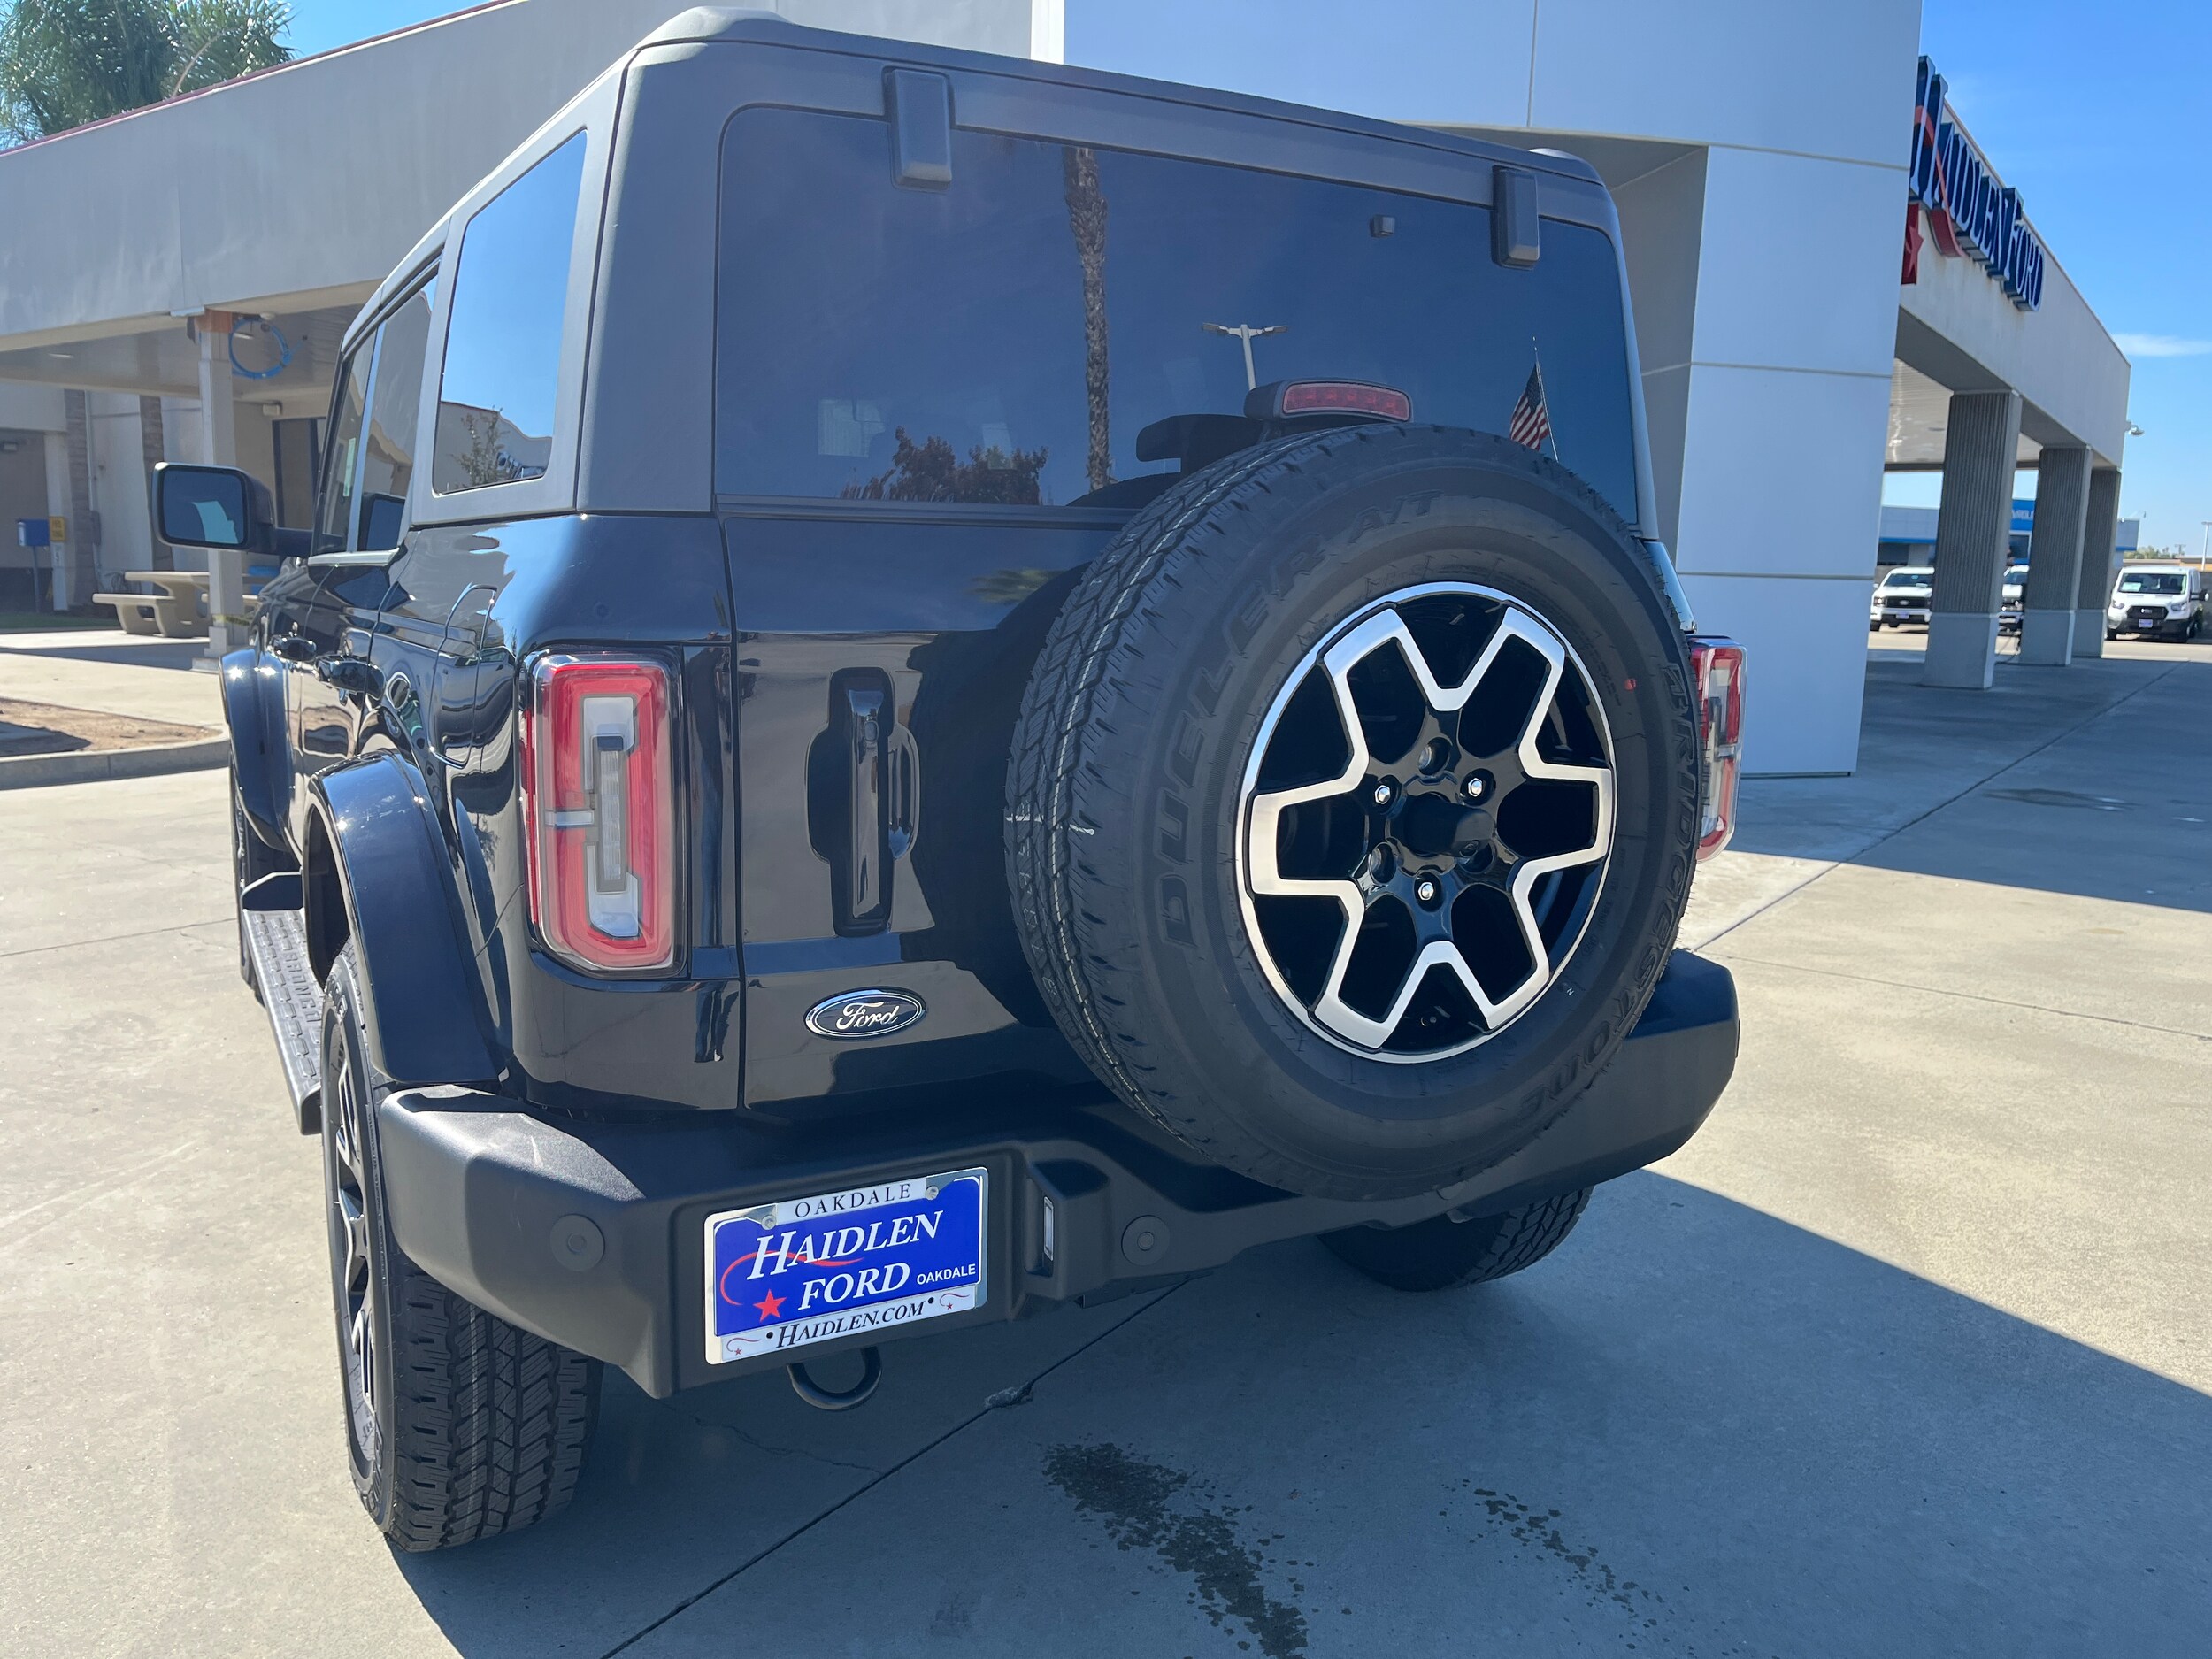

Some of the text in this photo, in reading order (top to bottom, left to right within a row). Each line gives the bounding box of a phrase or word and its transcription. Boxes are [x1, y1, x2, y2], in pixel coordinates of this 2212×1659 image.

[2004, 221, 2045, 311] FORD
[1154, 533, 1327, 947] DUELER
[1520, 662, 1698, 1118] BRIDGESTONE
[836, 1002, 899, 1030] Ford
[795, 1183, 910, 1217] OAKDALE
[747, 1210, 943, 1280] HAIDLEN
[798, 1262, 976, 1310] FORD OAKDALE
[775, 1300, 926, 1348] HAIDLEN.COM
